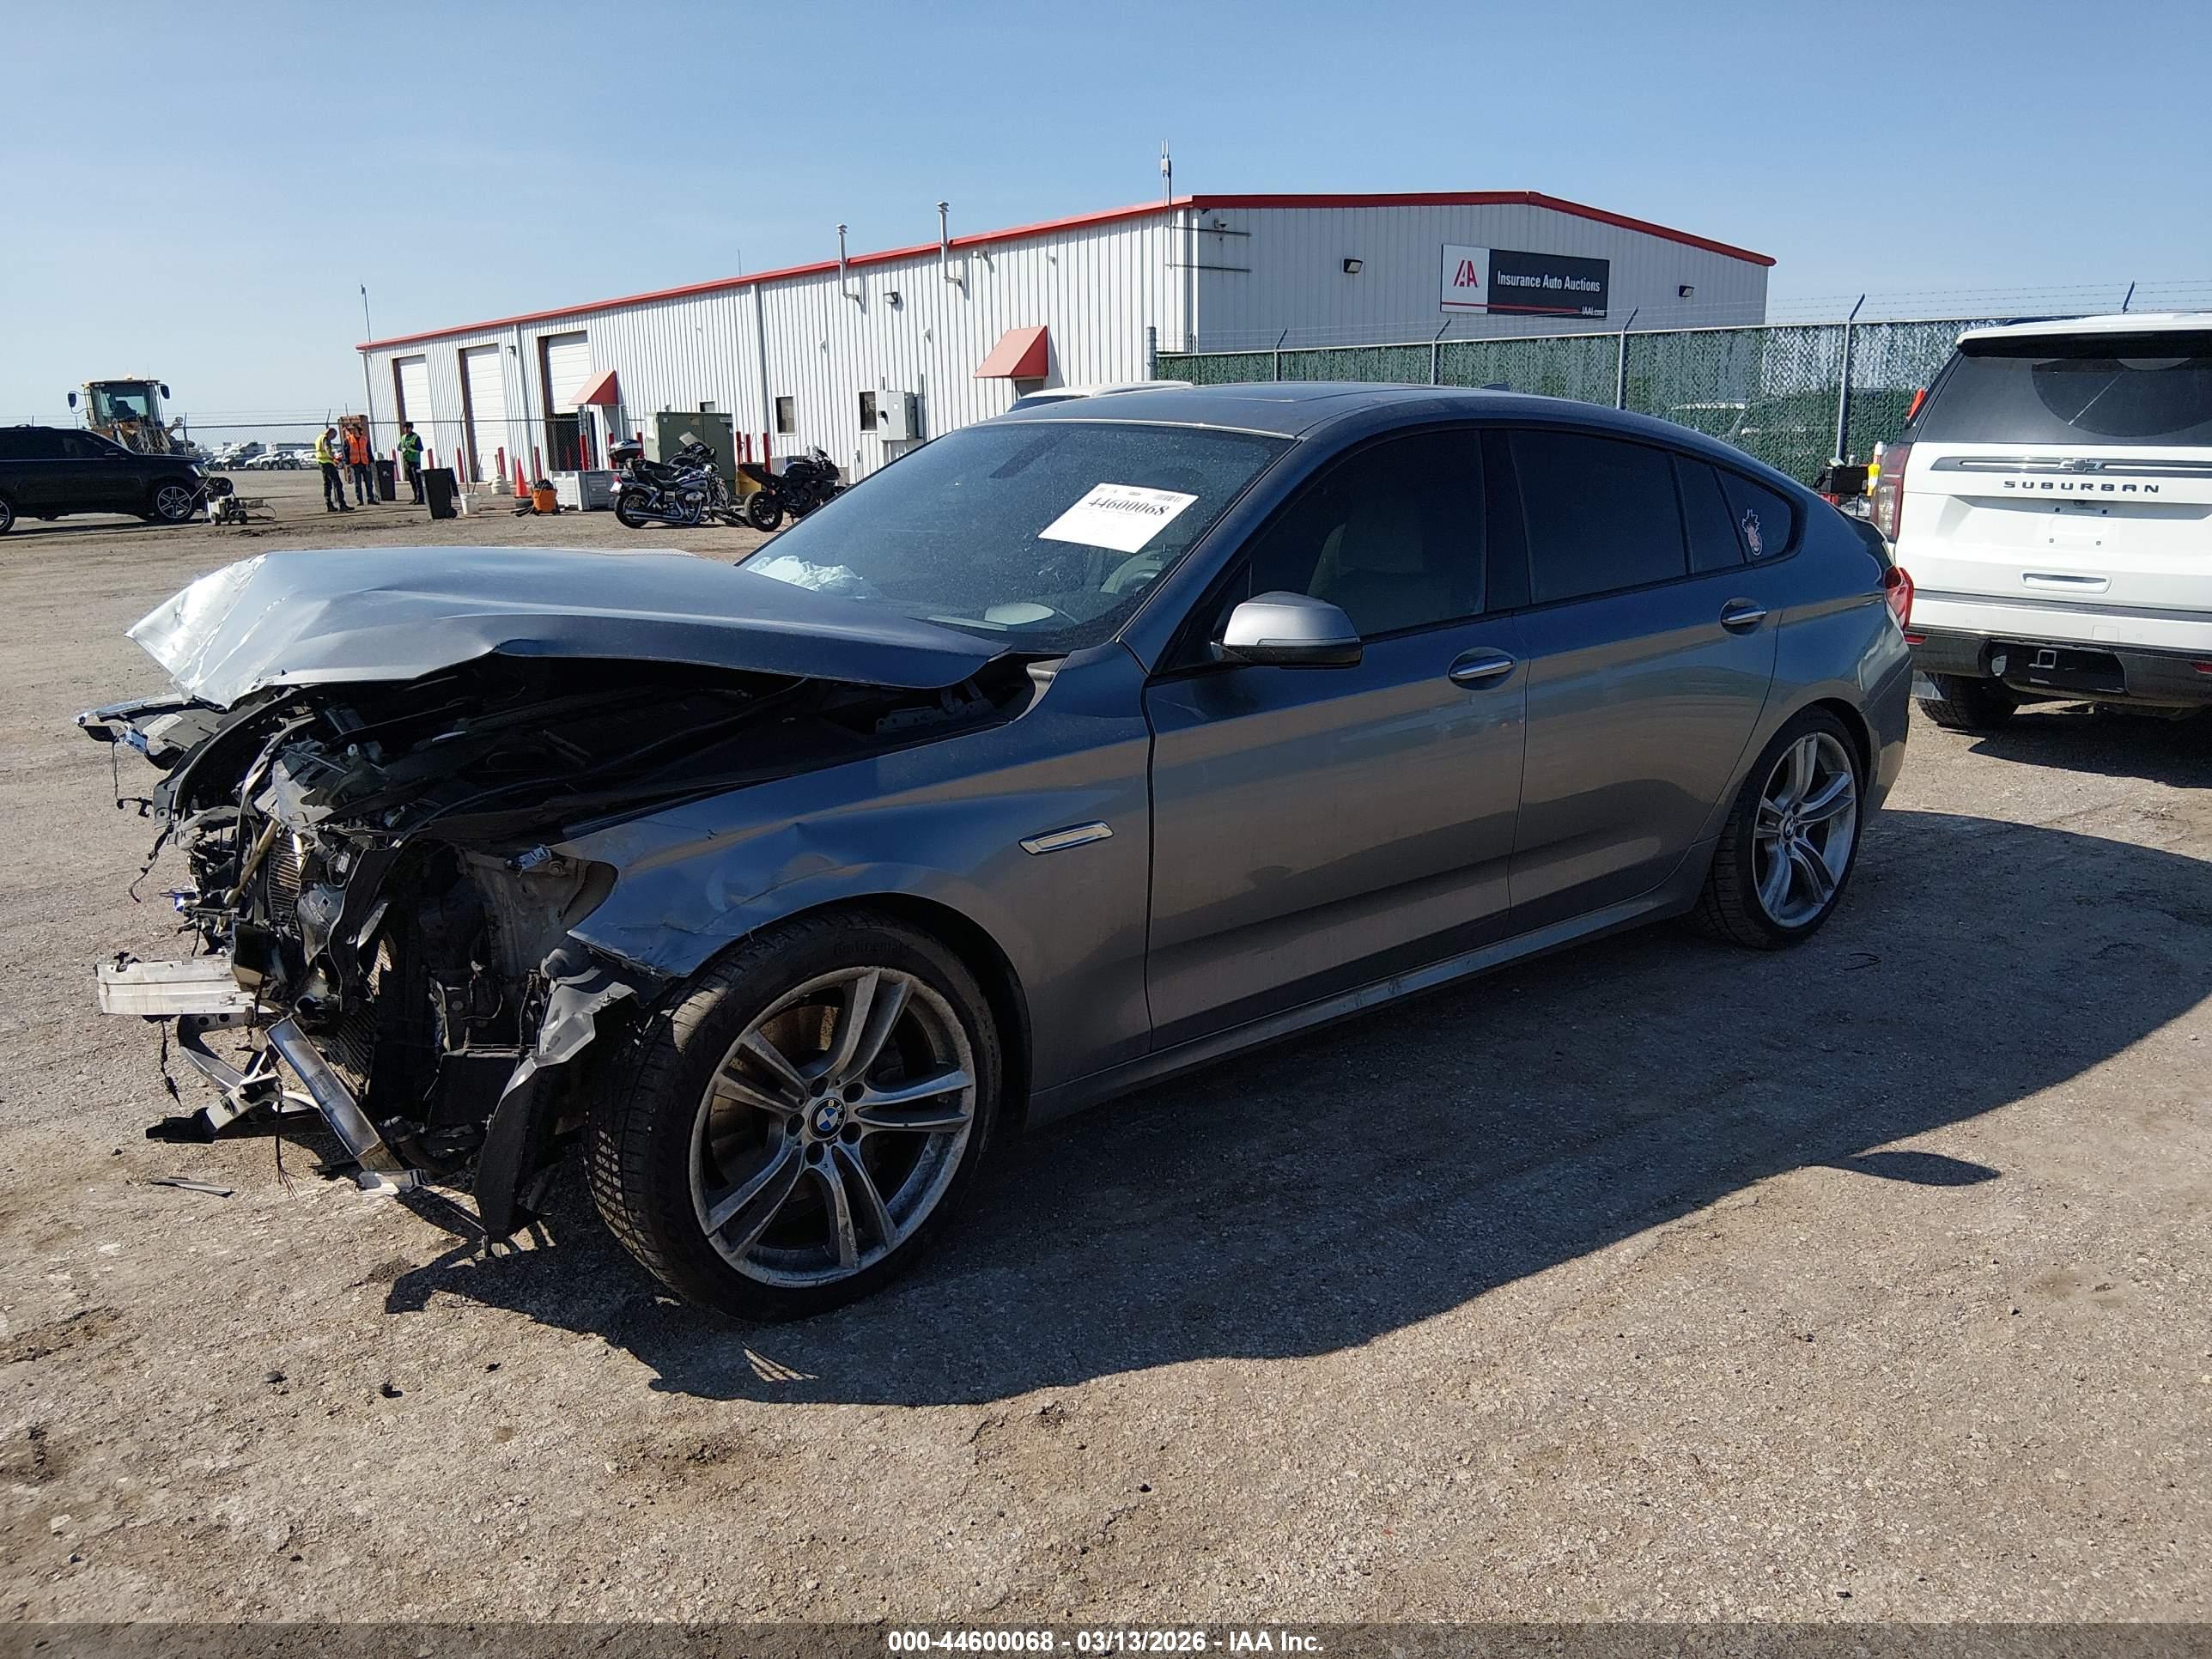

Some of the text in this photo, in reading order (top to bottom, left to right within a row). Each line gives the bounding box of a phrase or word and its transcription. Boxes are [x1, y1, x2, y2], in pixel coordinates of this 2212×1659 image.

[1497, 270, 1601, 293] Insurance Auto Auctions
[2003, 481, 2160, 493] SUBURBAN
[1088, 497, 1170, 516] 44600068
